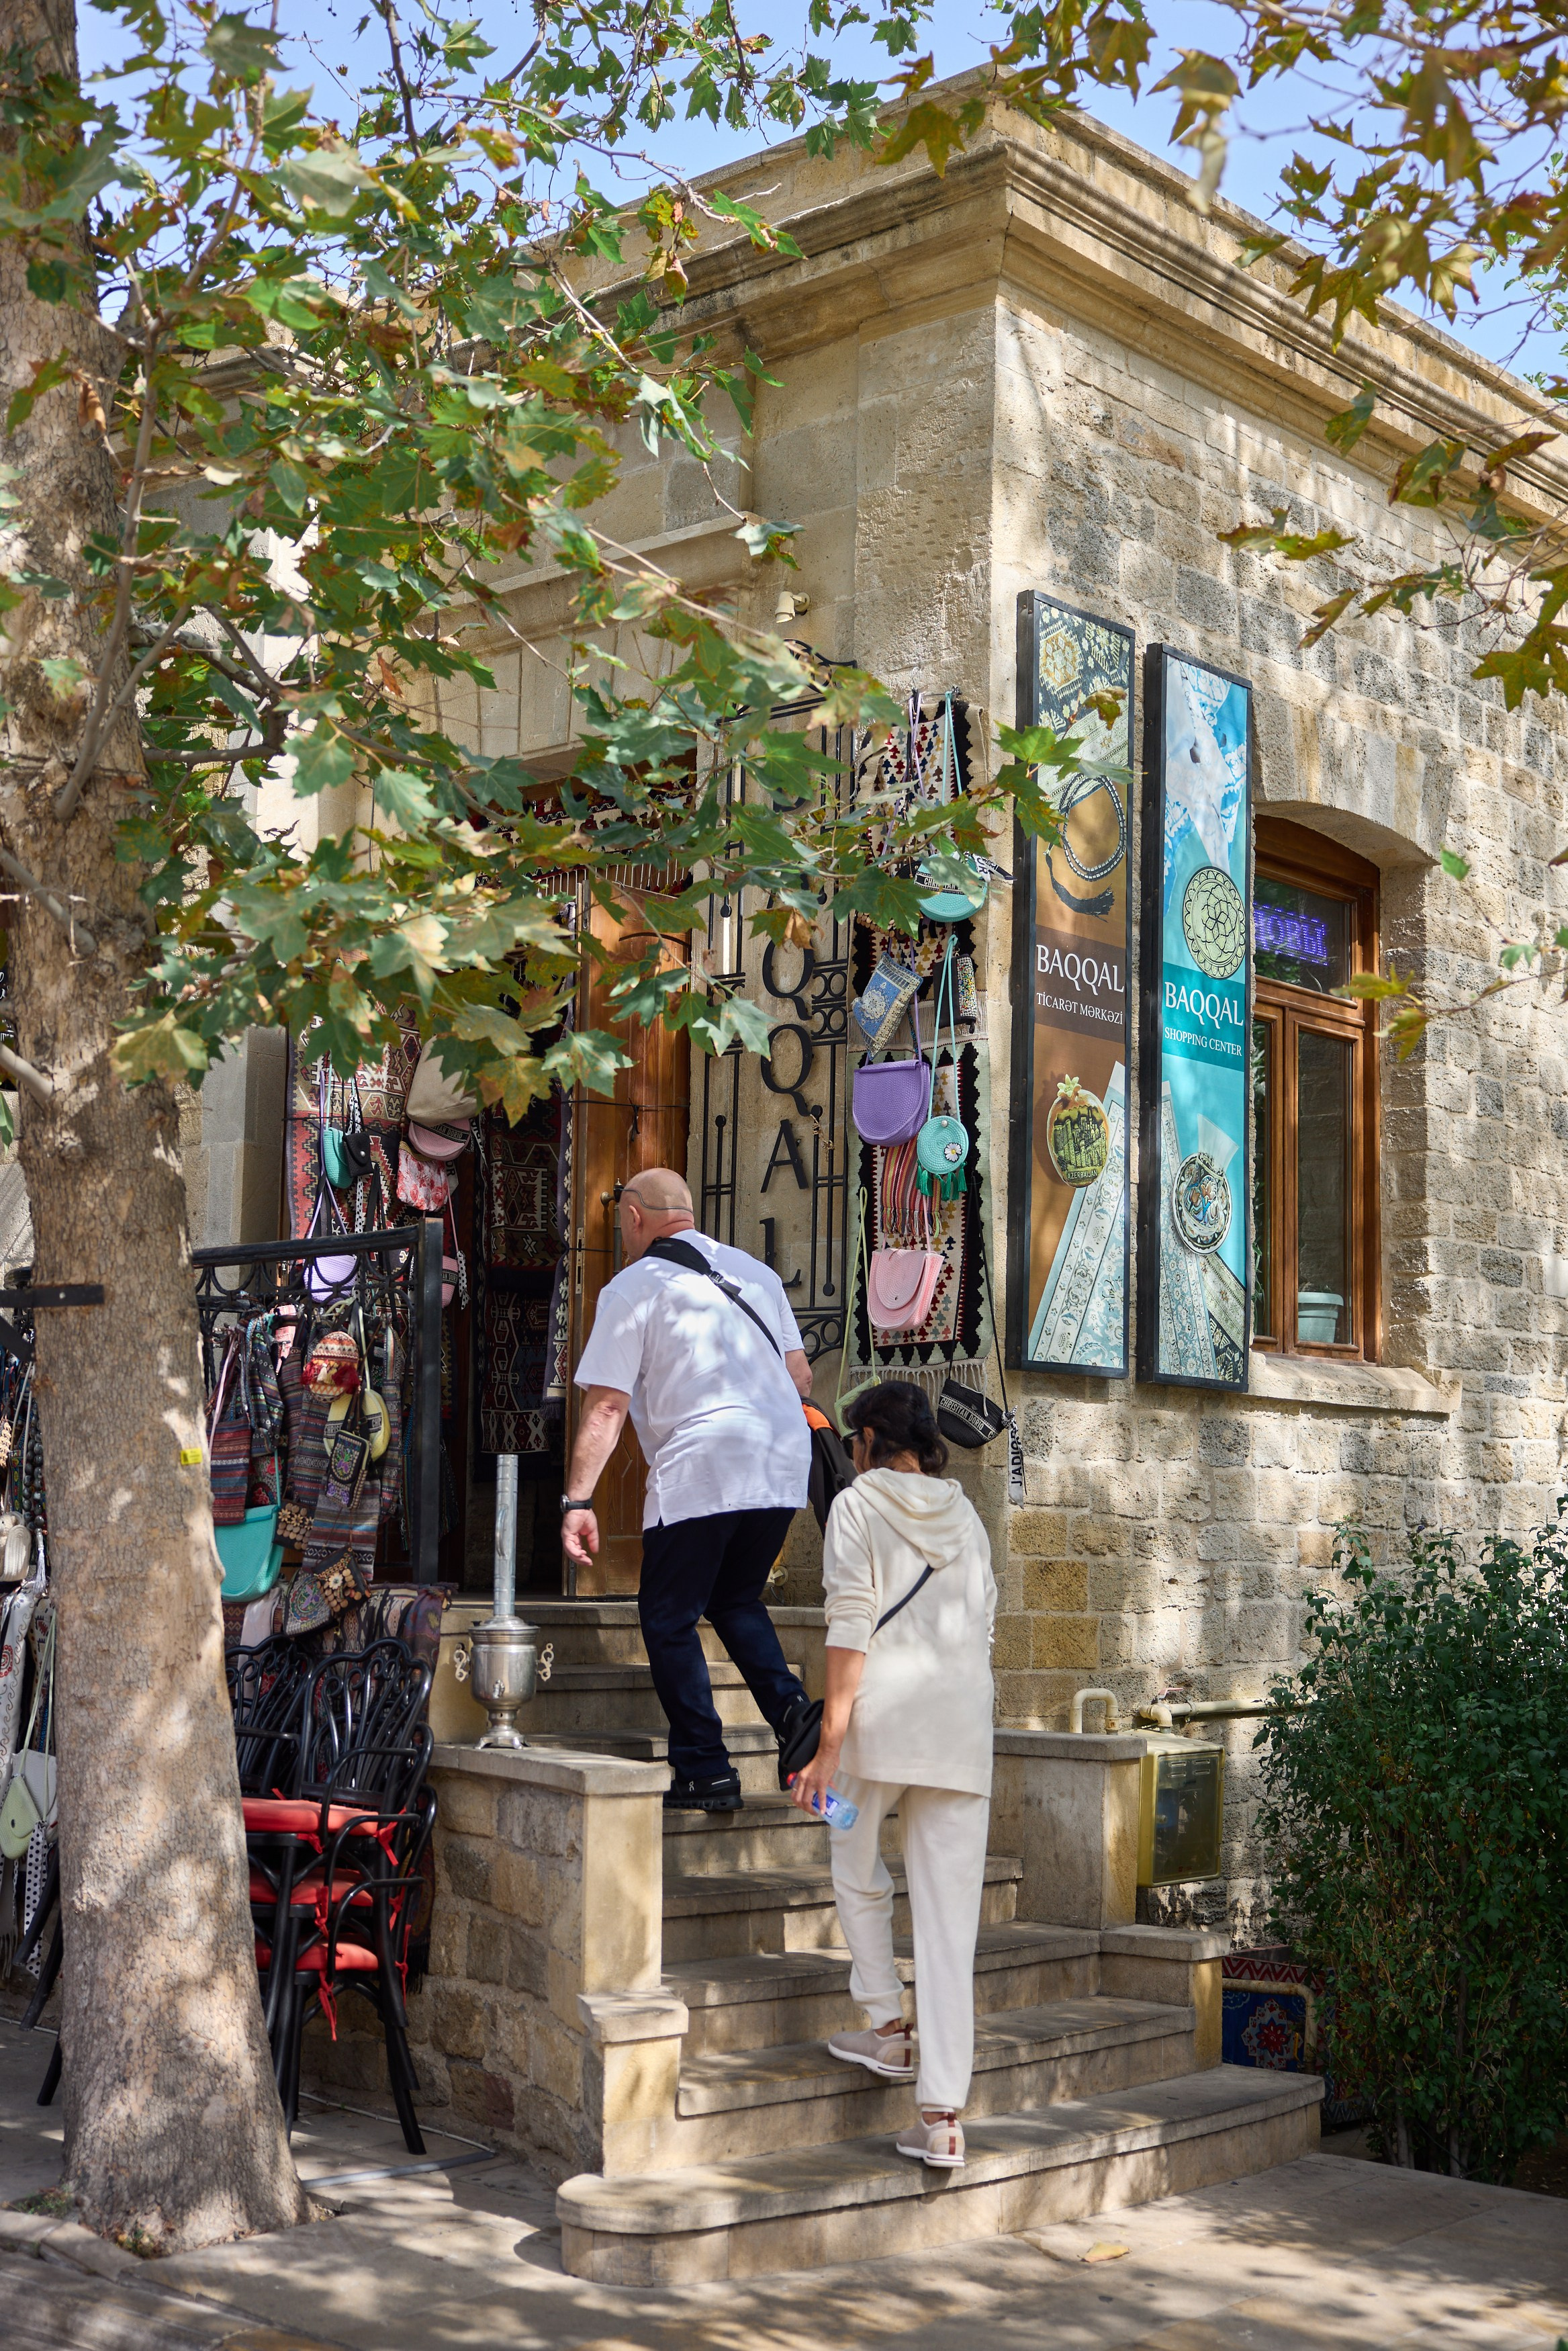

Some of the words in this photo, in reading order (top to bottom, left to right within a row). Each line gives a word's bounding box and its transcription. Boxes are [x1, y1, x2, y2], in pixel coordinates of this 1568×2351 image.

[1036, 944, 1124, 995] BAQQAL
[1036, 991, 1078, 1014] TİCARƏT
[1080, 1004, 1123, 1025] MƏRKƏZİ
[1164, 981, 1244, 1029] BAQQAL
[1164, 1026, 1207, 1048] SHOPPING
[1209, 1038, 1242, 1057] CENTER
[1067, 1169, 1098, 1180] AZERBAIJAN
[968, 1415, 984, 1431] DORIO
